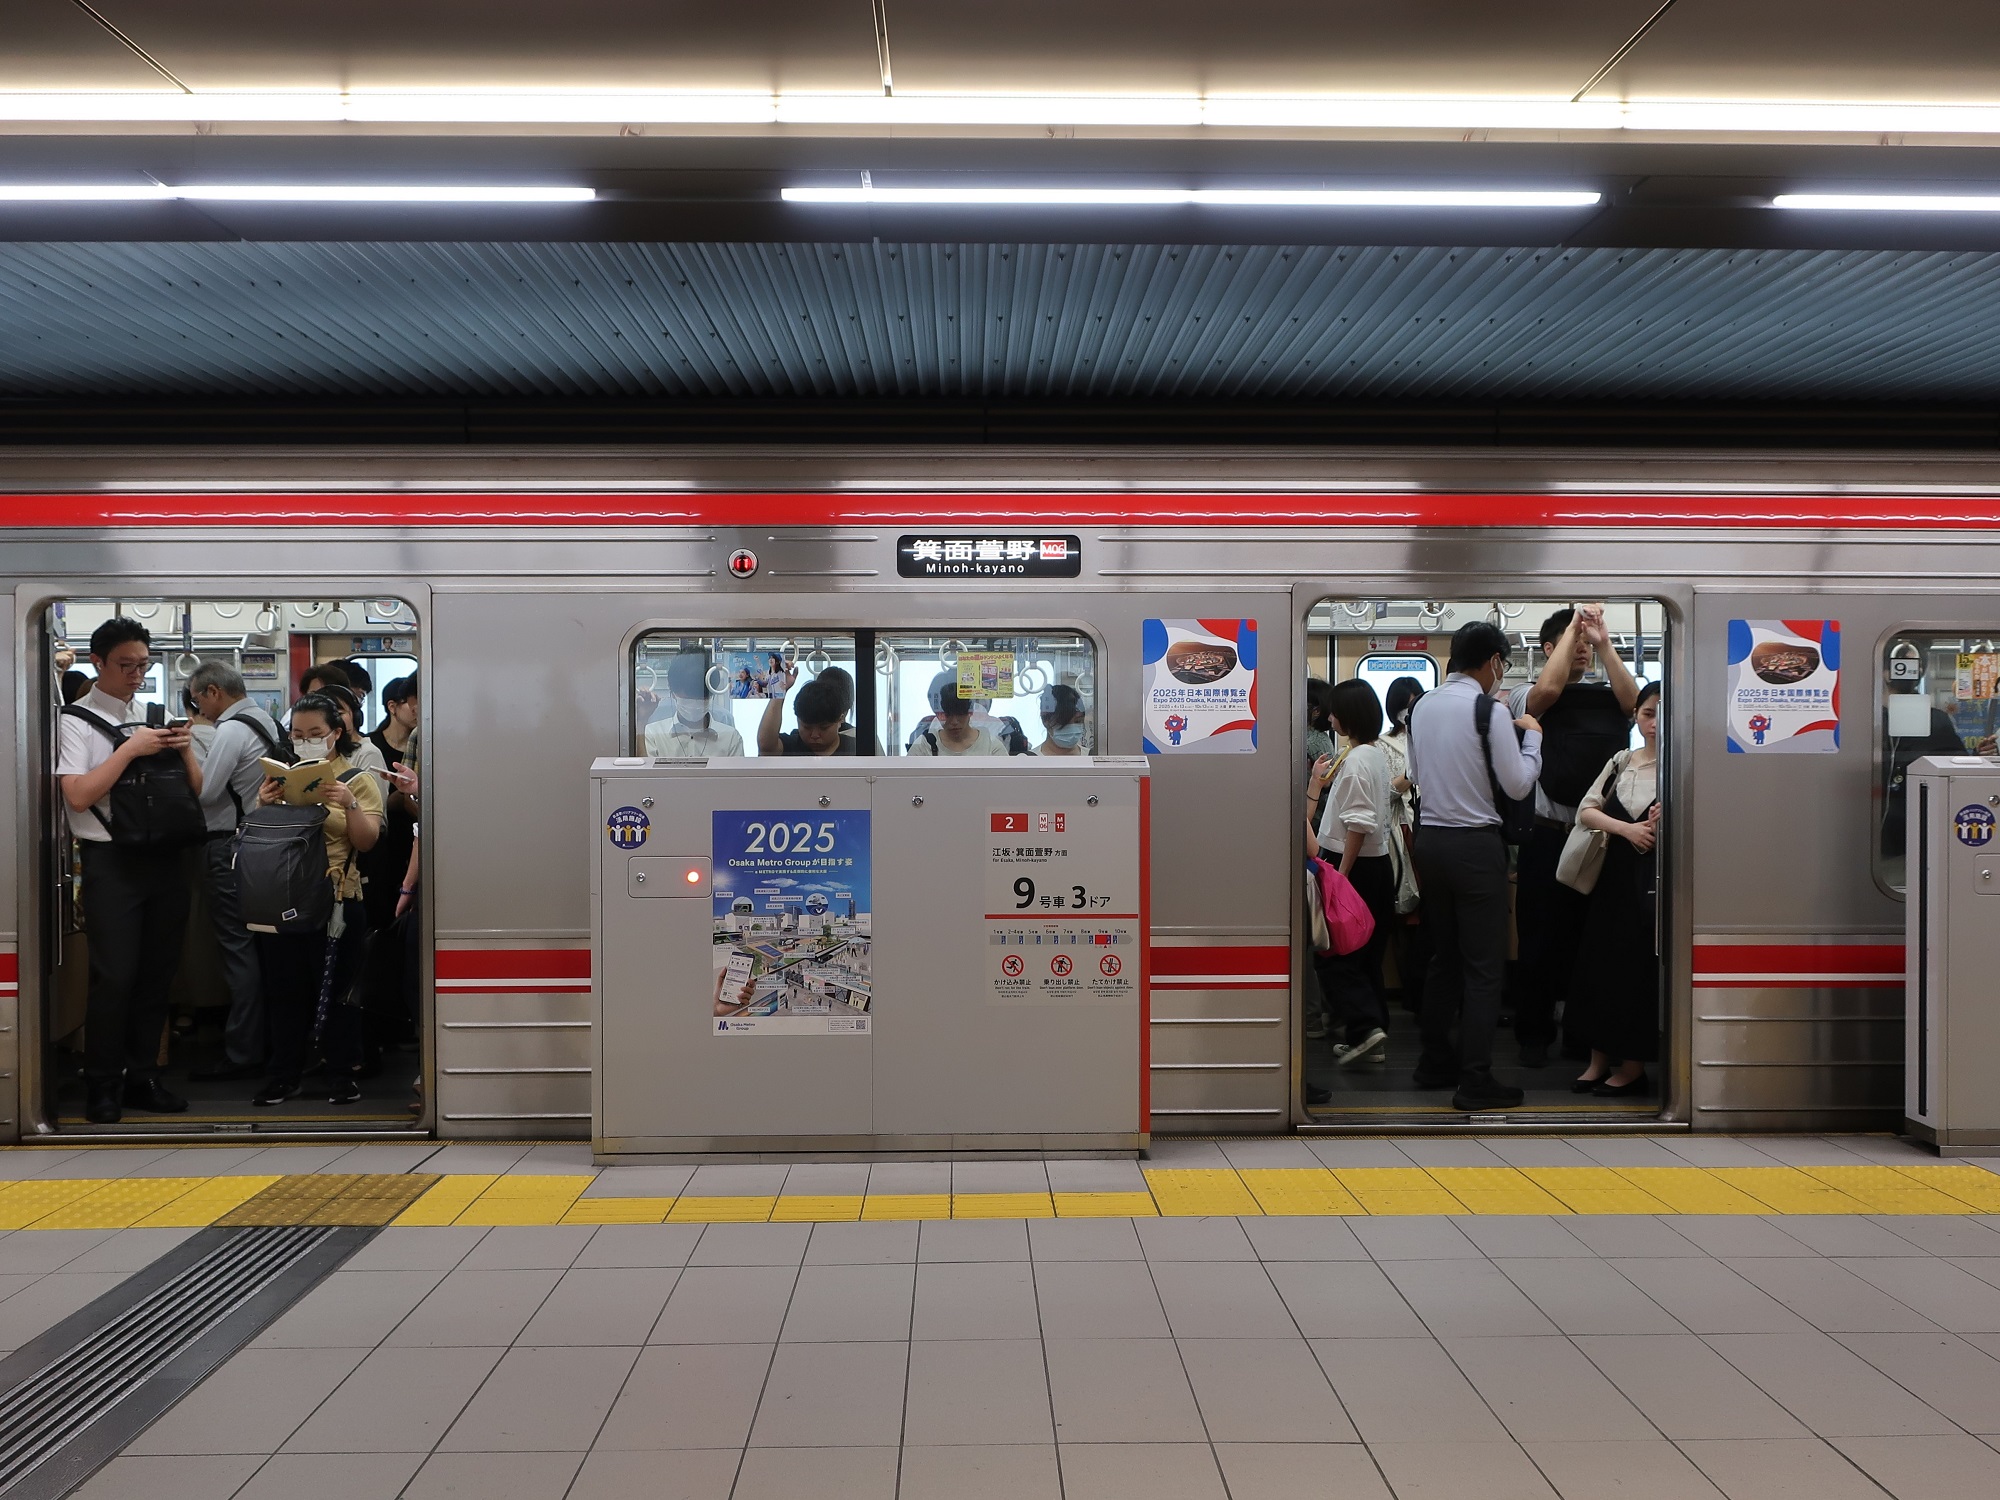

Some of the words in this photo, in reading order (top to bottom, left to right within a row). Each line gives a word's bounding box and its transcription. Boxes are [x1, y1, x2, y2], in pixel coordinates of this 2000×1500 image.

[913, 539, 1036, 561] 箕面萱野
[1042, 544, 1065, 555] M06
[926, 563, 1025, 575] Minoh-kayano
[1153, 688, 1247, 697] 2025年日本国際博覧会
[1005, 816, 1014, 829] 2
[744, 822, 835, 853] 2025
[992, 847, 1053, 857] 江坂・箕面萱野
[1055, 849, 1068, 857] 方面
[728, 858, 755, 867] Osaka
[757, 858, 783, 867] Metro
[784, 858, 811, 868] Group
[993, 978, 1032, 986] かけ込み禁止
[1043, 978, 1080, 986] 乗り出し禁止
[1092, 978, 1129, 986] たてかけ禁止
